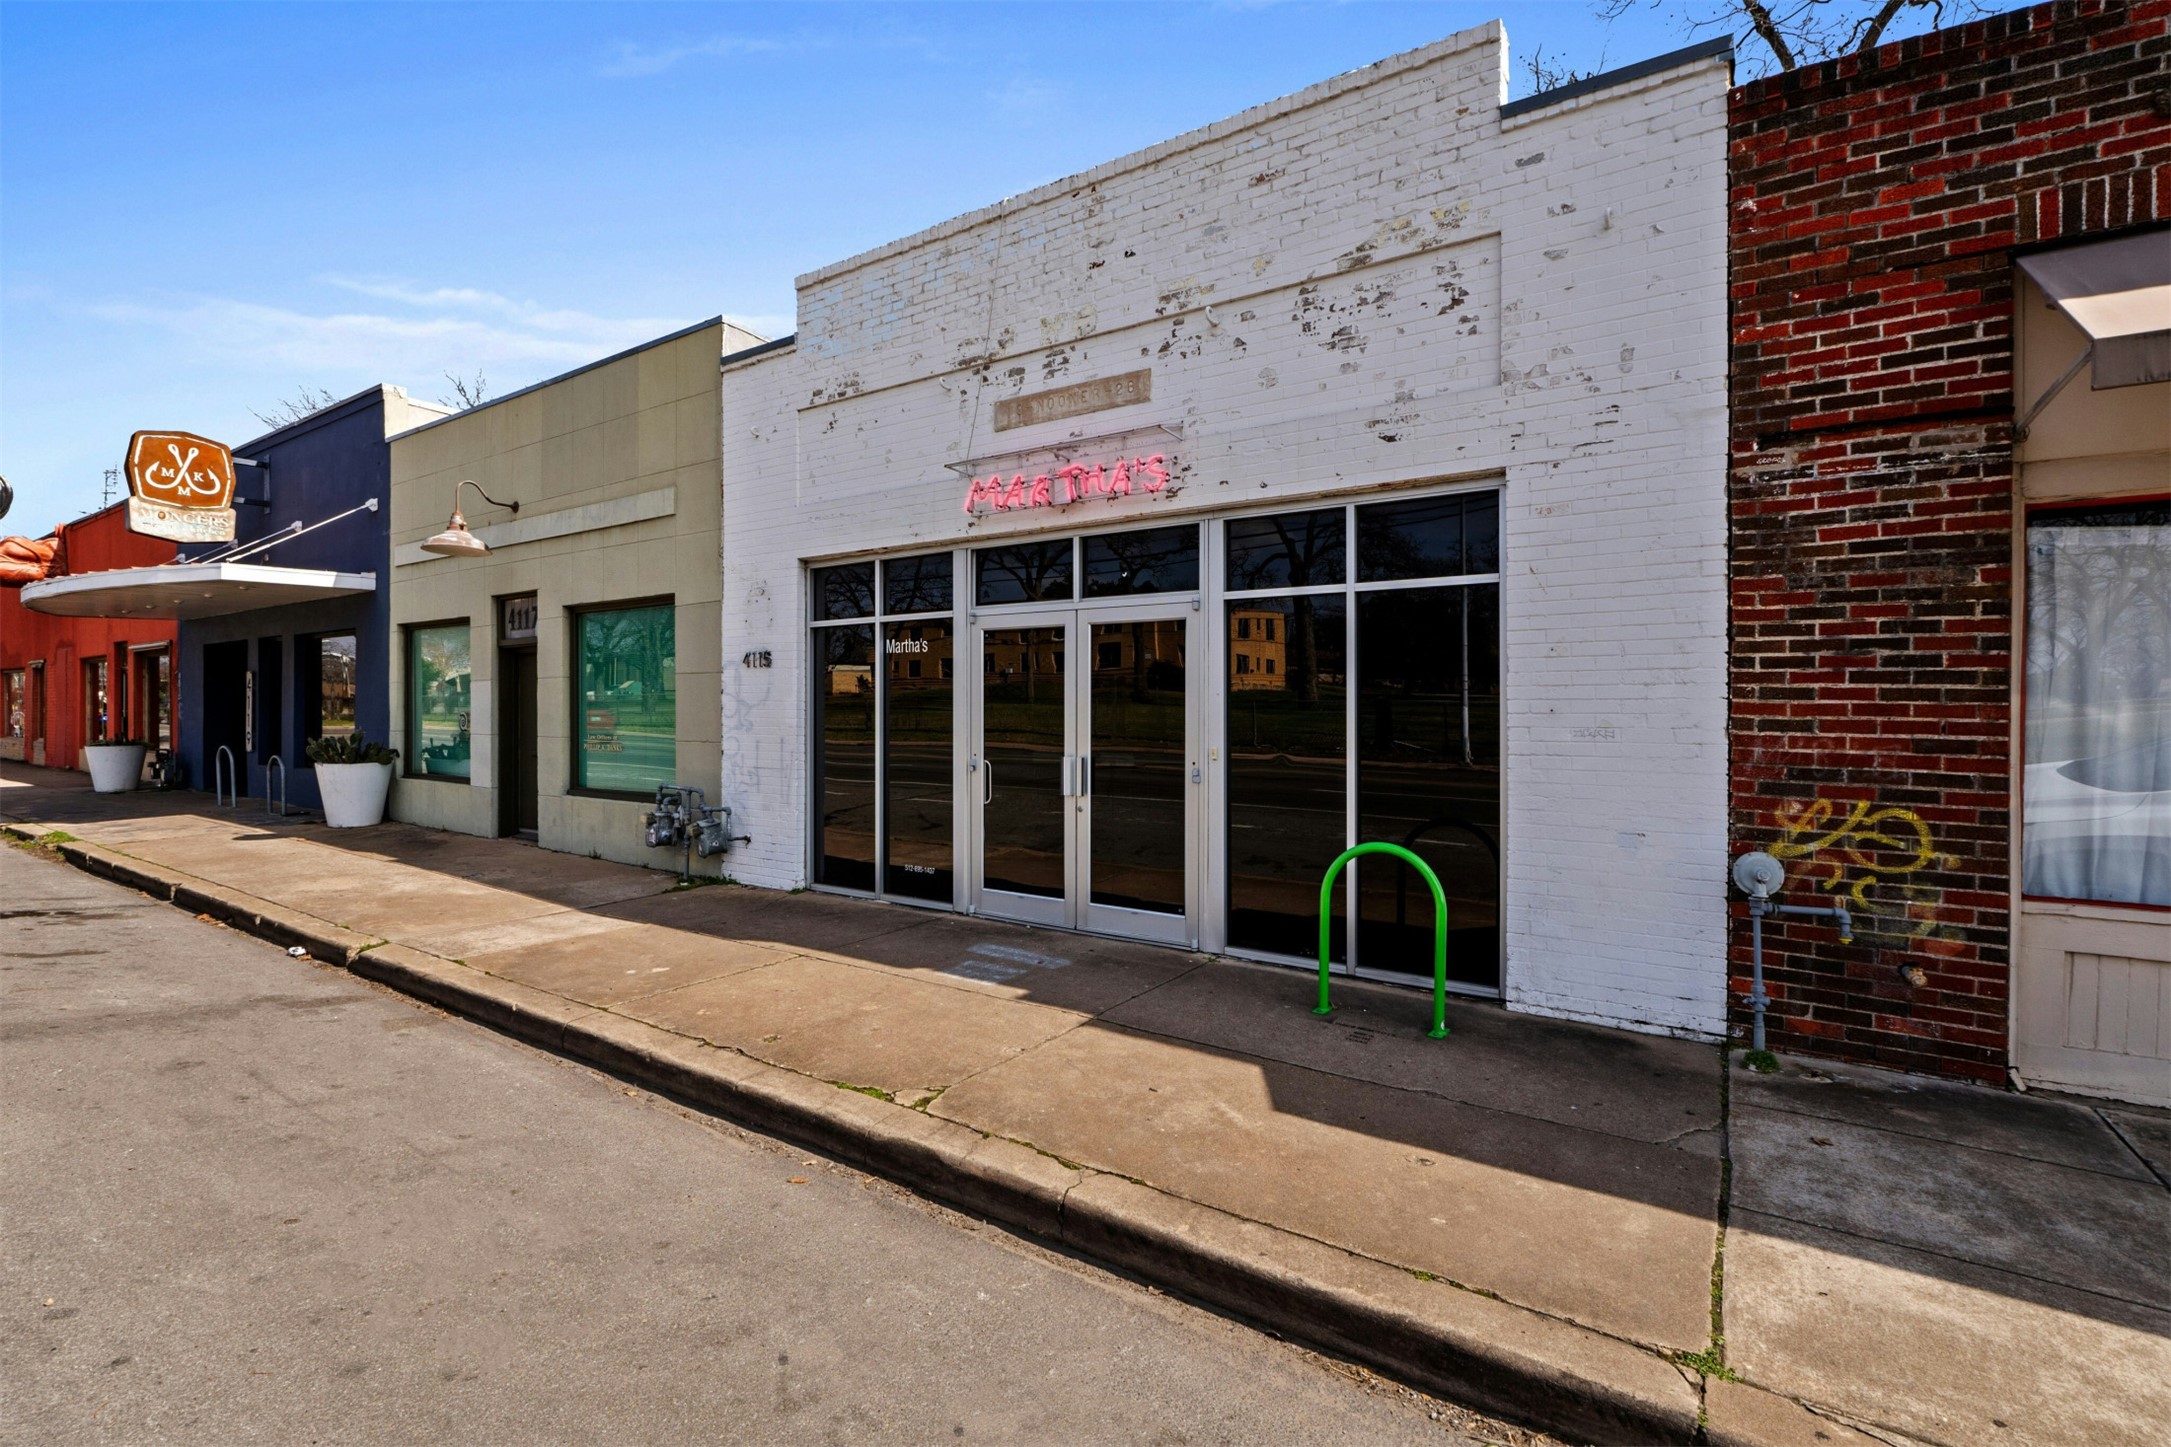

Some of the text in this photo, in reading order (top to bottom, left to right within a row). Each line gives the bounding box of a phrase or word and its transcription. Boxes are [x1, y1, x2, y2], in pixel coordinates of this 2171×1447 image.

[161, 467, 205, 482] M K
[177, 485, 191, 496] M
[964, 455, 1171, 515] MARTHA'S
[509, 606, 538, 631] 4117
[886, 639, 928, 654] Martha's
[742, 650, 773, 669] 4115
